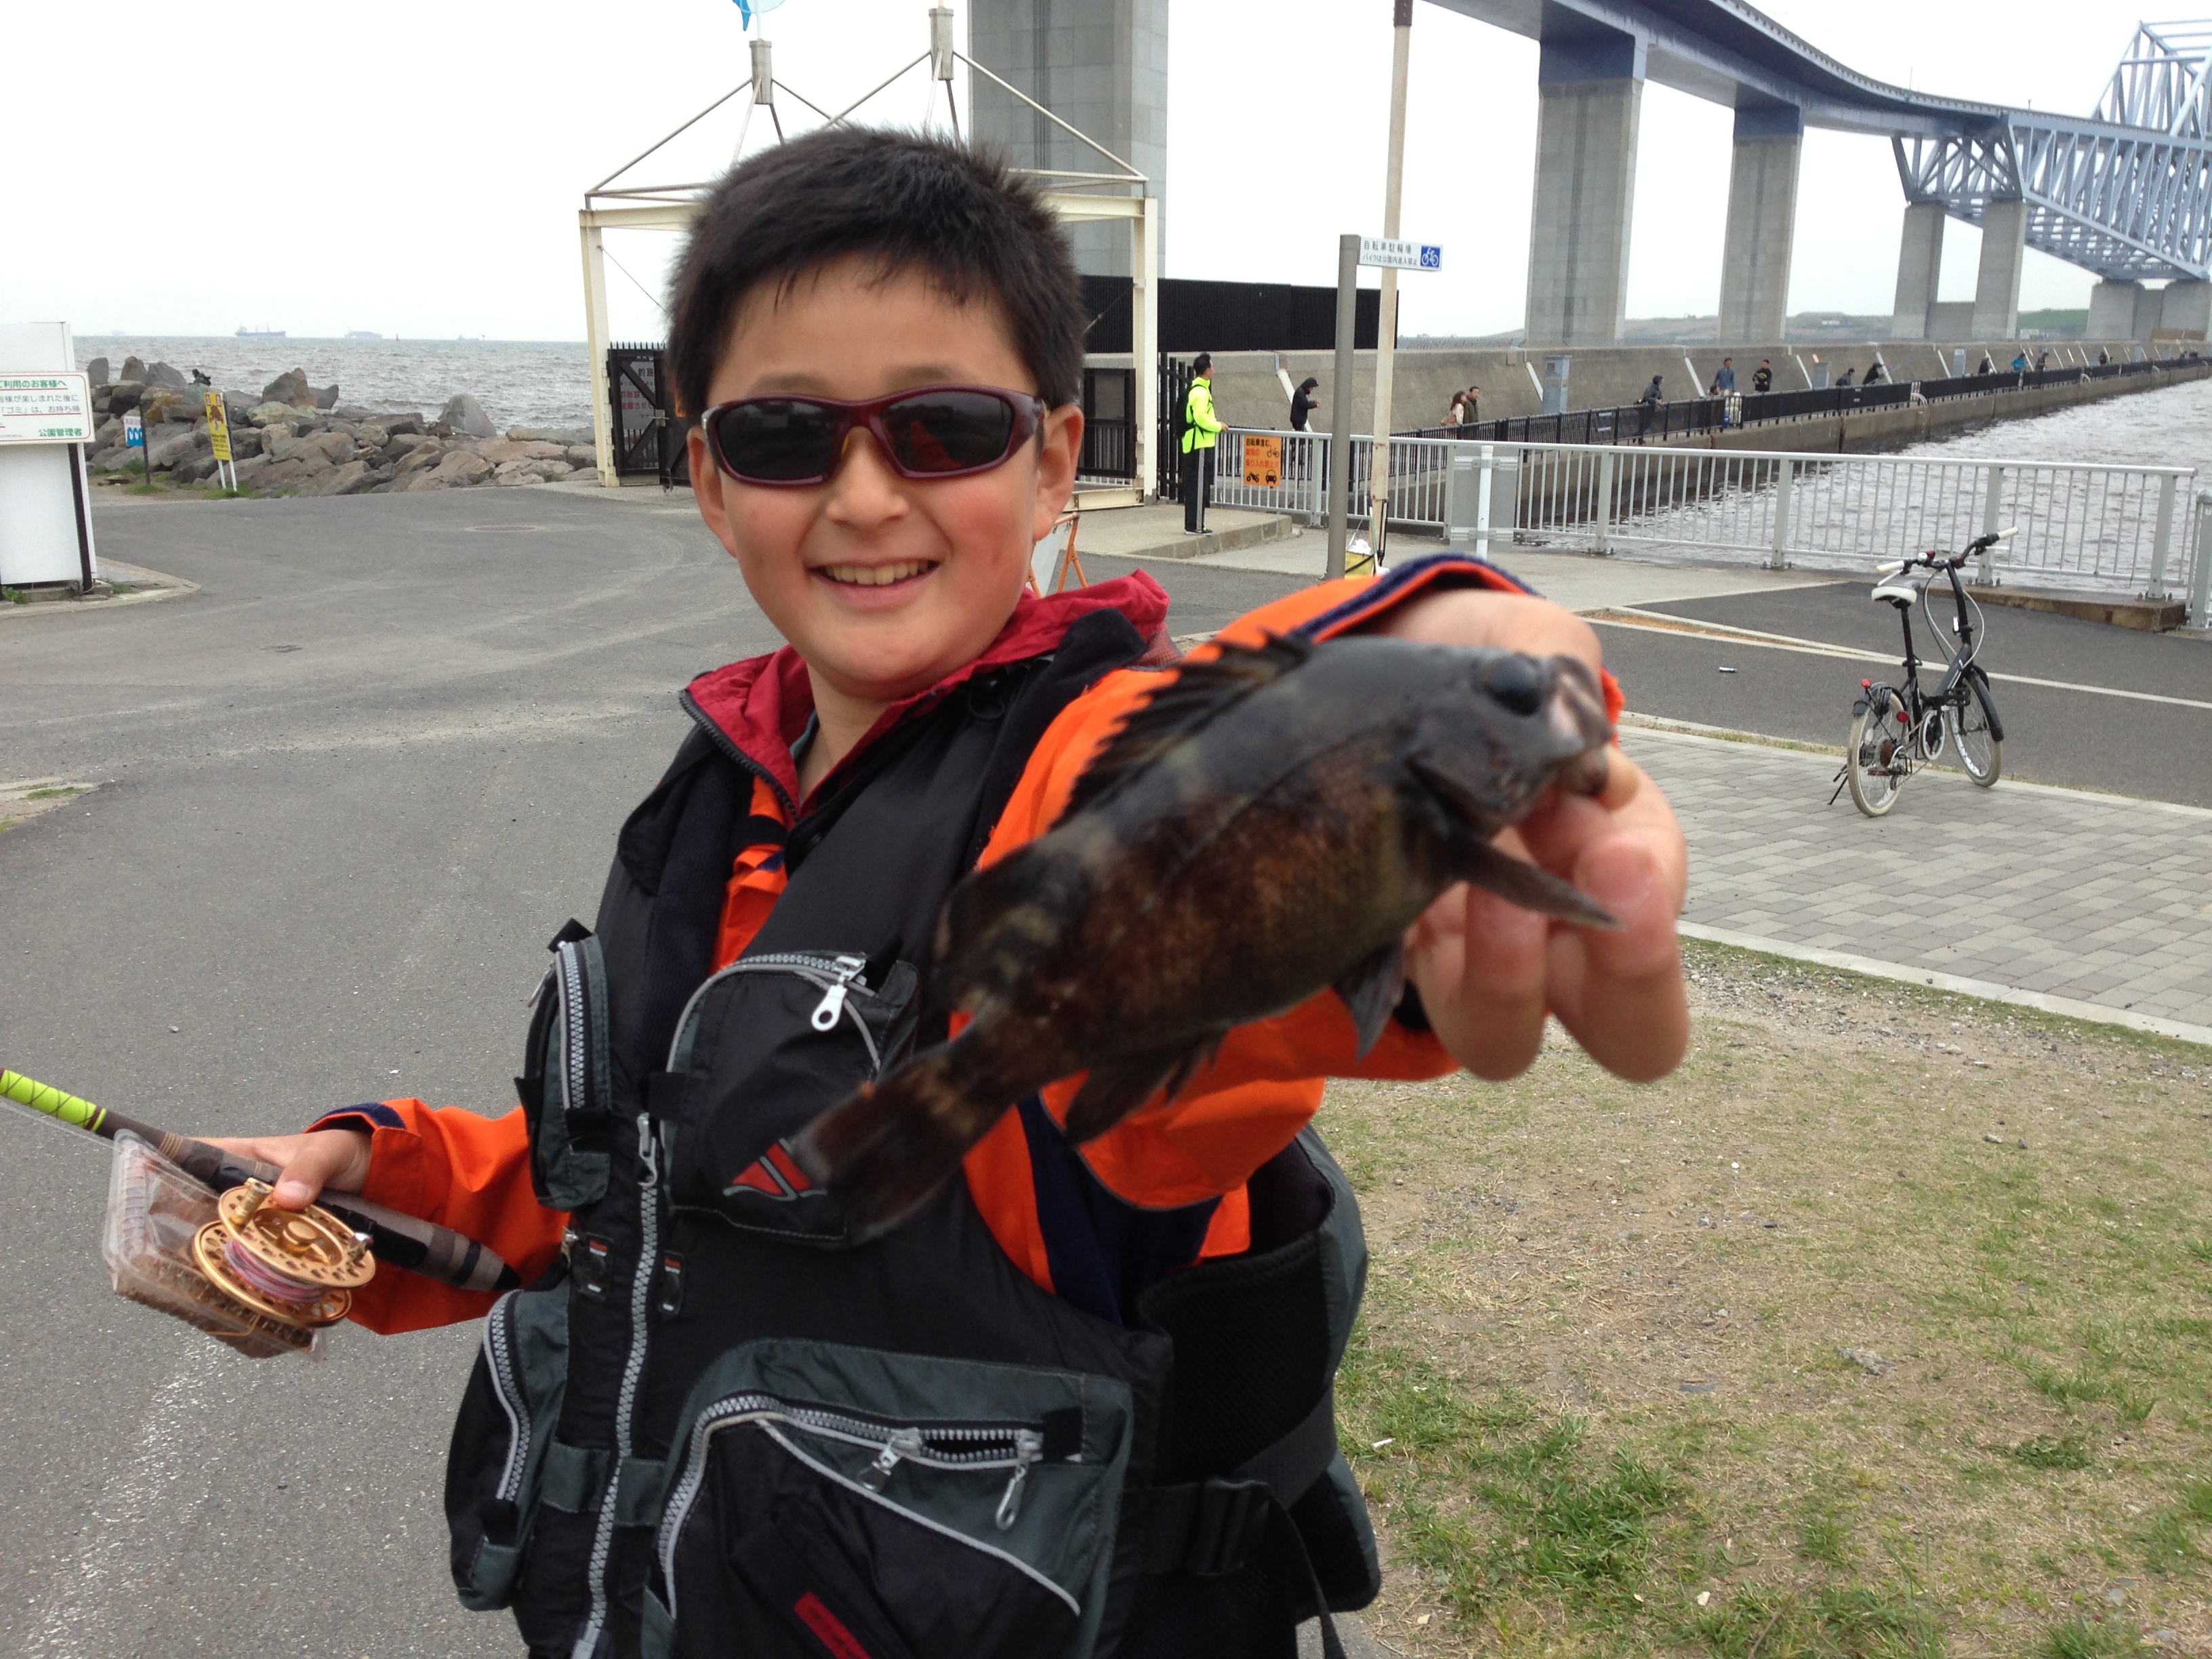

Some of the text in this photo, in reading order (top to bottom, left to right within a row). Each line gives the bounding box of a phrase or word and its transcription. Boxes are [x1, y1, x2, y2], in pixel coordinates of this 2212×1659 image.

[1364, 241, 1412, 253] 自転車駐輪場
[39, 428, 83, 436] 公園管理者
